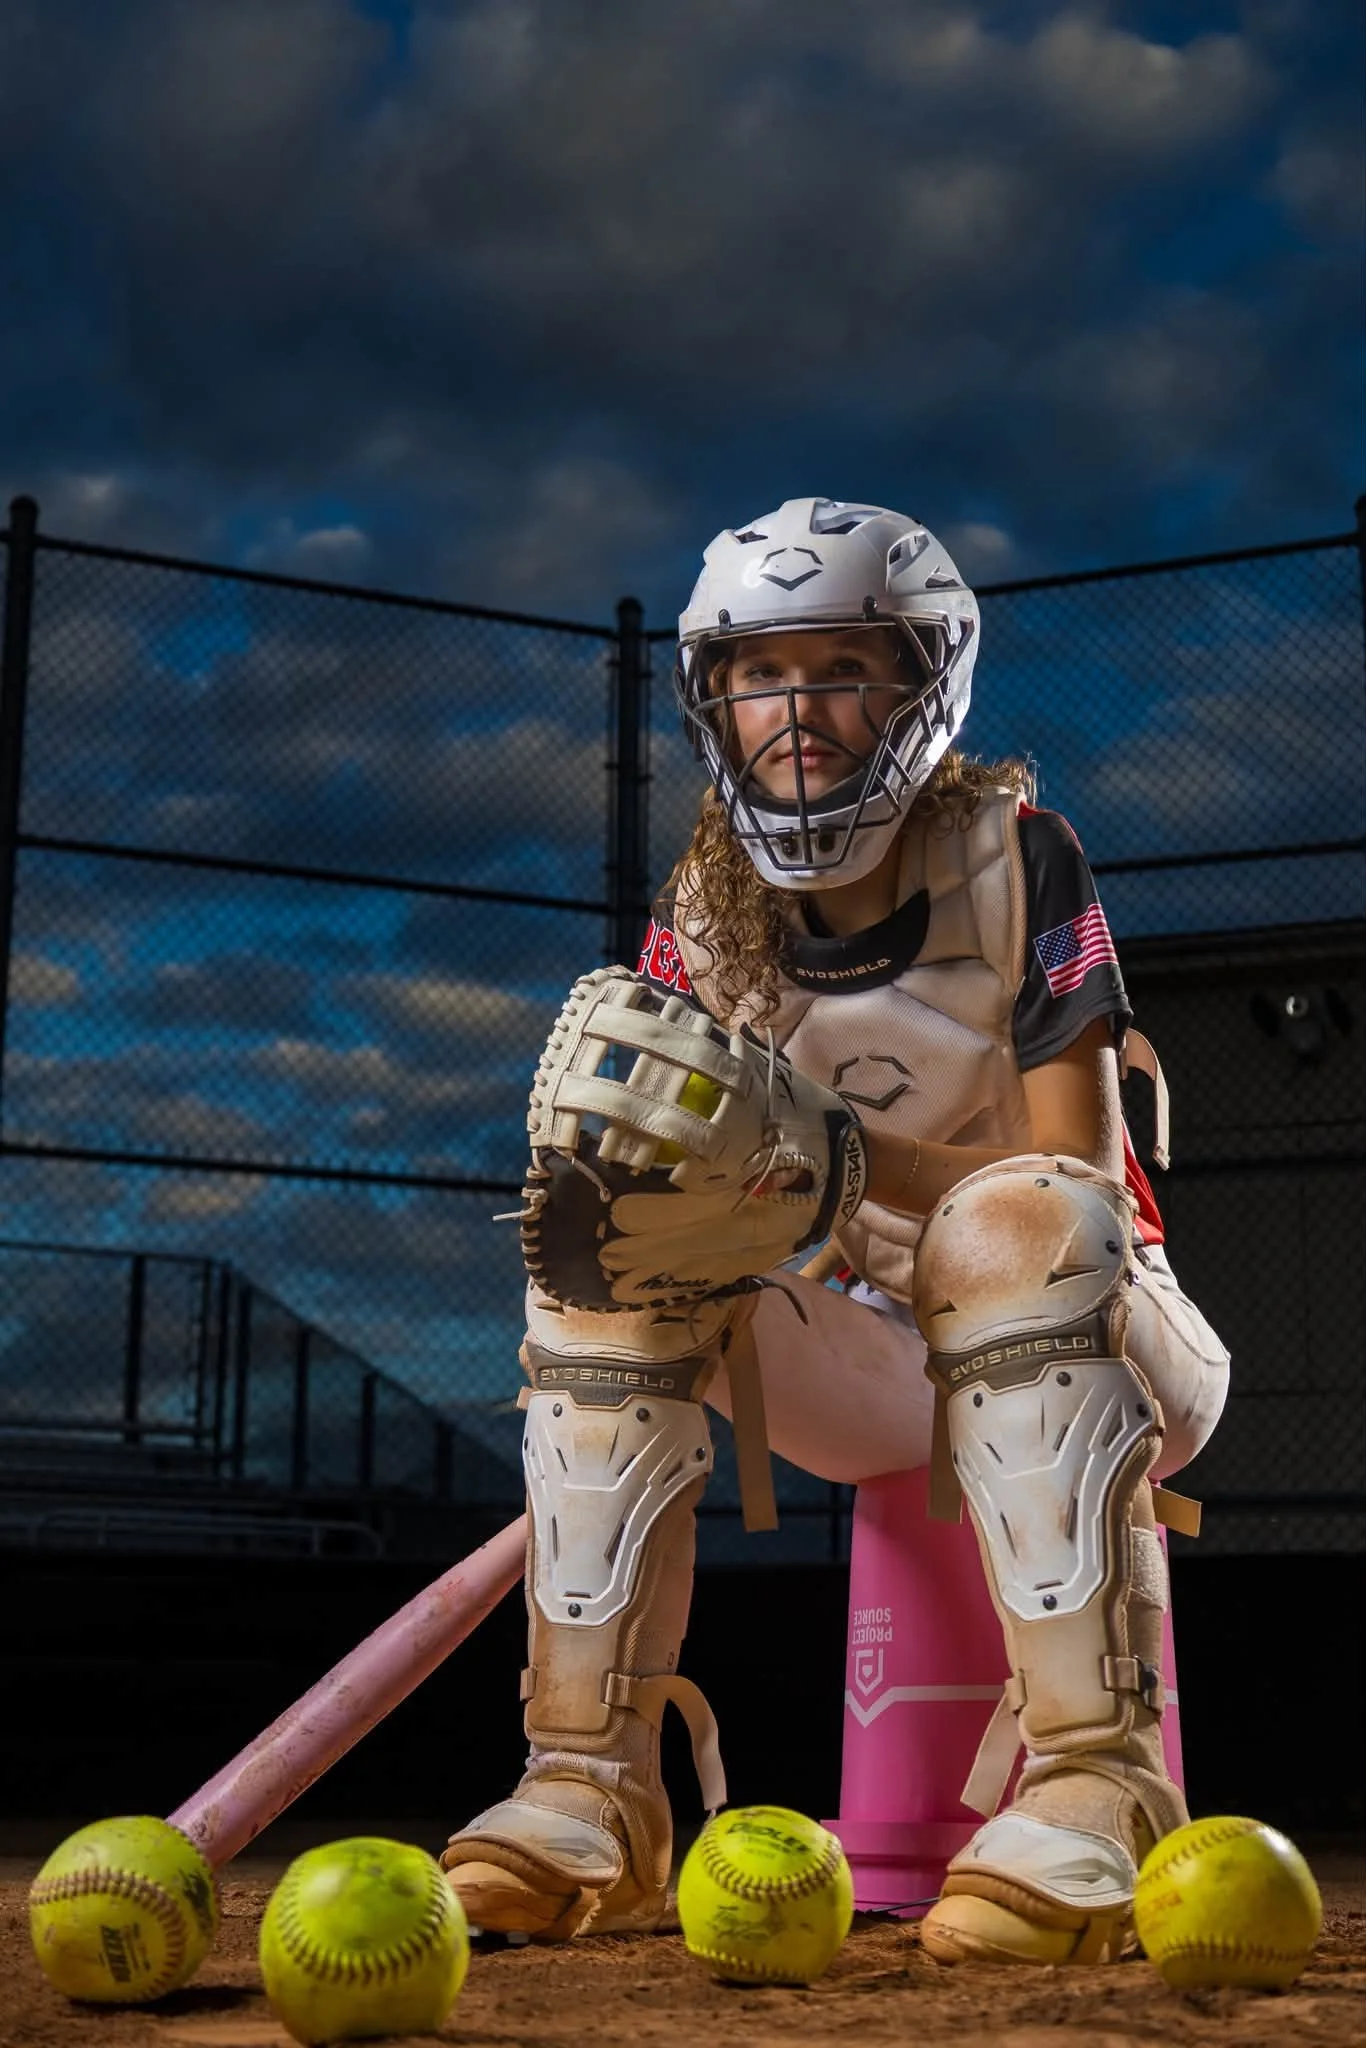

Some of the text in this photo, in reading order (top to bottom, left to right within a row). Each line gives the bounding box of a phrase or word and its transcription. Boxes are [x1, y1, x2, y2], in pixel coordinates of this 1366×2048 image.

[950, 1336, 1089, 1382] EVOSHIELD
[540, 1368, 675, 1390] EVOSHIELD
[853, 1607, 892, 1626] SOURCE
[852, 1626, 893, 1645] PROJECT
